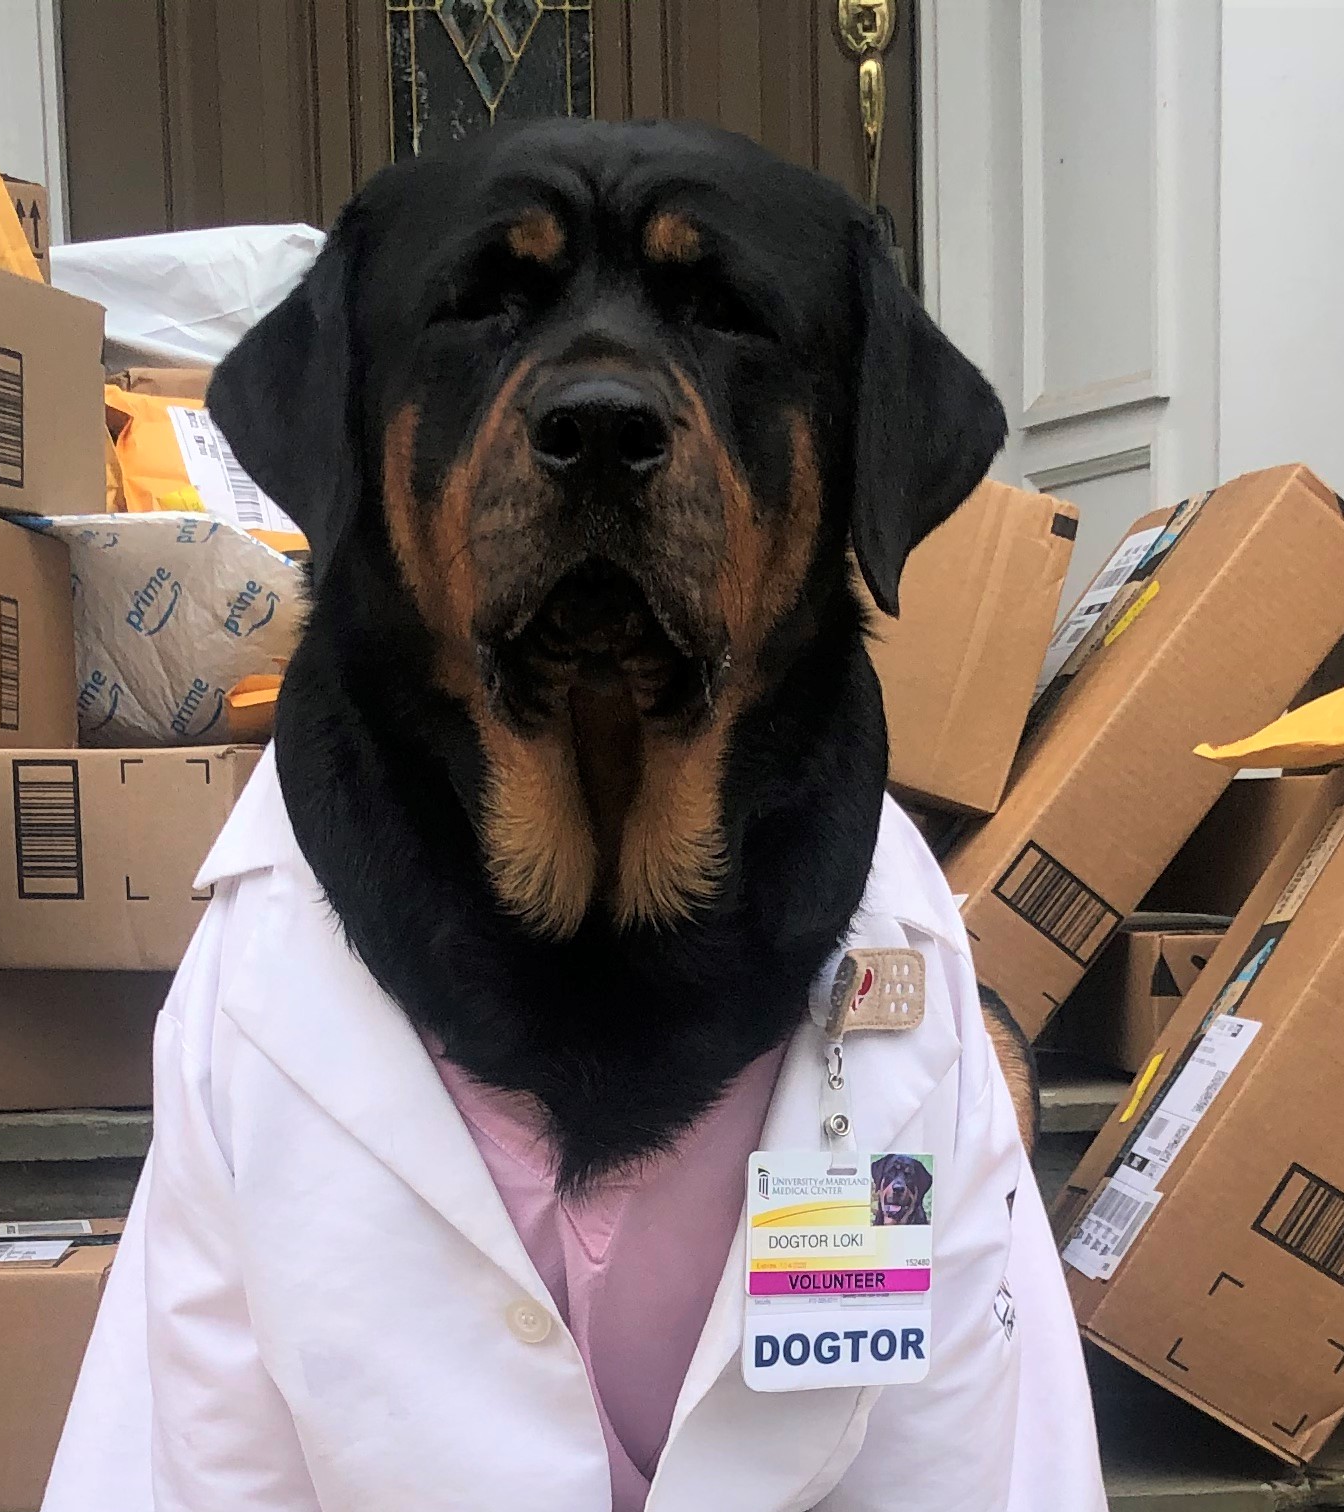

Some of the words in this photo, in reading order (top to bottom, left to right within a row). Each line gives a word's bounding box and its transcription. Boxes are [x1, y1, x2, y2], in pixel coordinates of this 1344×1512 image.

[126, 567, 171, 632] prime
[224, 580, 263, 637] prime
[170, 677, 210, 736] prime
[772, 1177, 818, 1187] UNIVERSITY
[826, 1177, 869, 1186] MARYLAND
[772, 1187, 809, 1195] MEDICAL
[810, 1186, 843, 1195] CENTER
[768, 1234, 828, 1249] DOGTOR
[833, 1233, 863, 1247] LOKI
[789, 1273, 886, 1290] VOLUNTEER
[755, 1327, 926, 1368] DOGTOR
